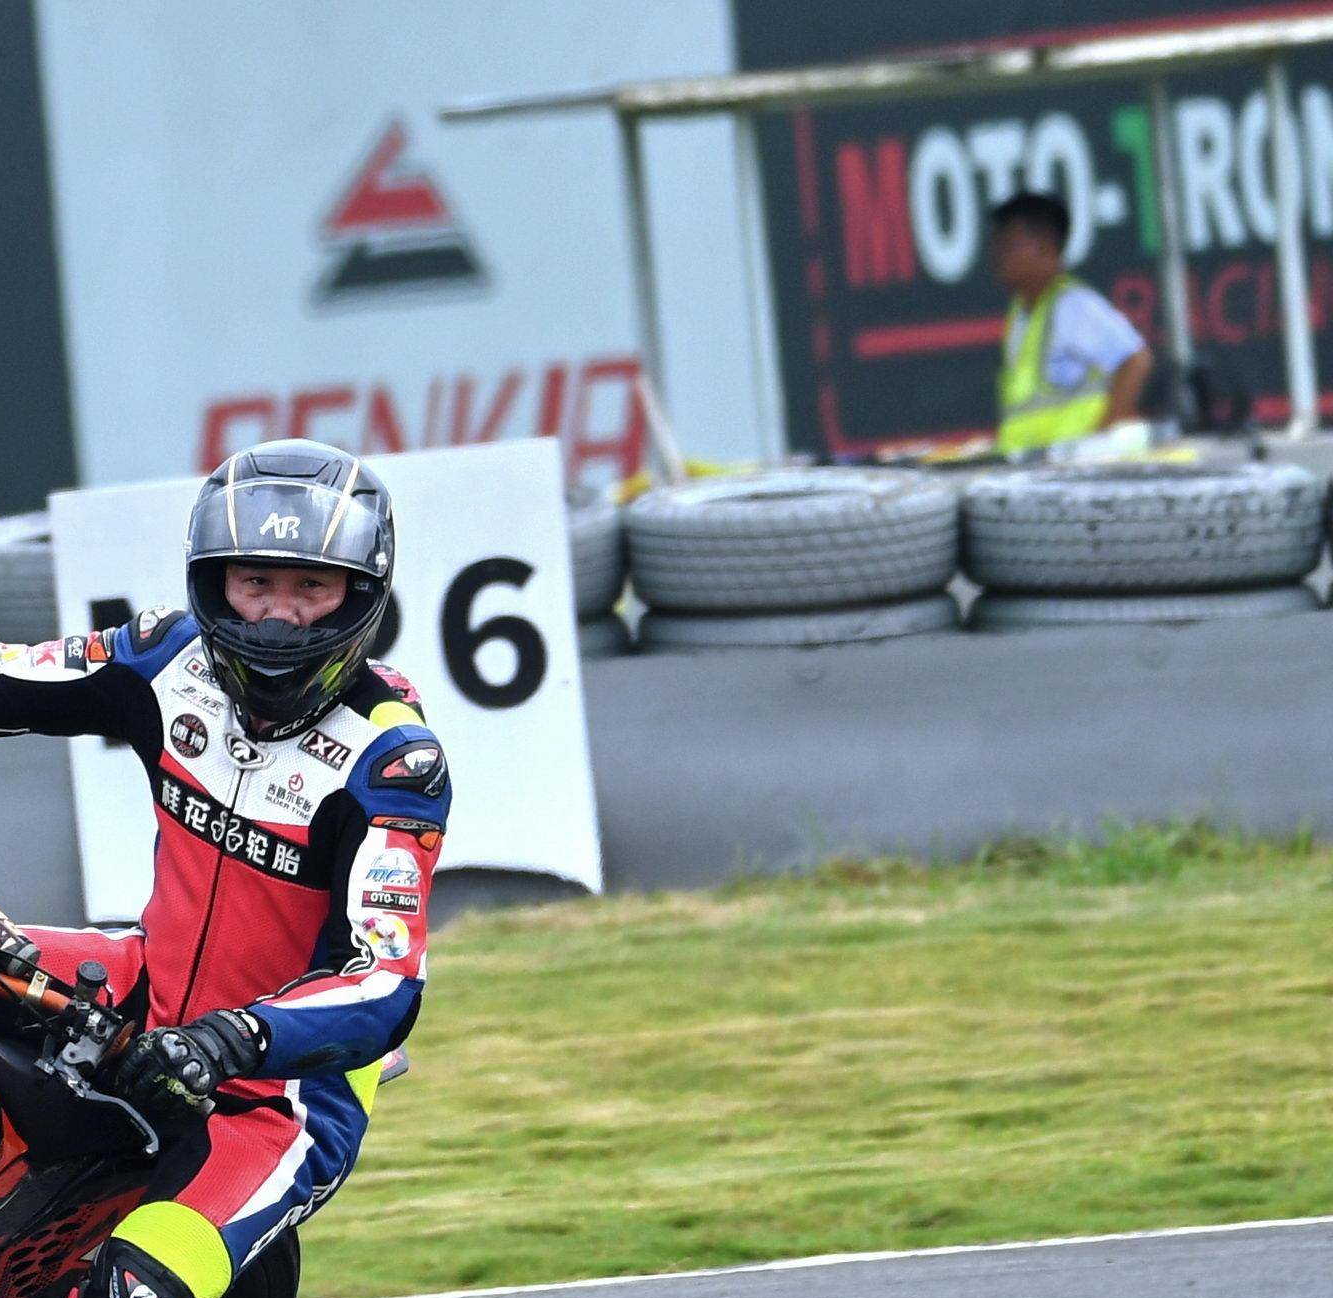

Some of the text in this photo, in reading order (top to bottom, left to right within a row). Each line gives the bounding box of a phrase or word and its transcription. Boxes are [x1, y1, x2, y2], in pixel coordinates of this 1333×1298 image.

[302, 731, 349, 765] IXIL
[161, 779, 301, 877] 桂花 轮胎
